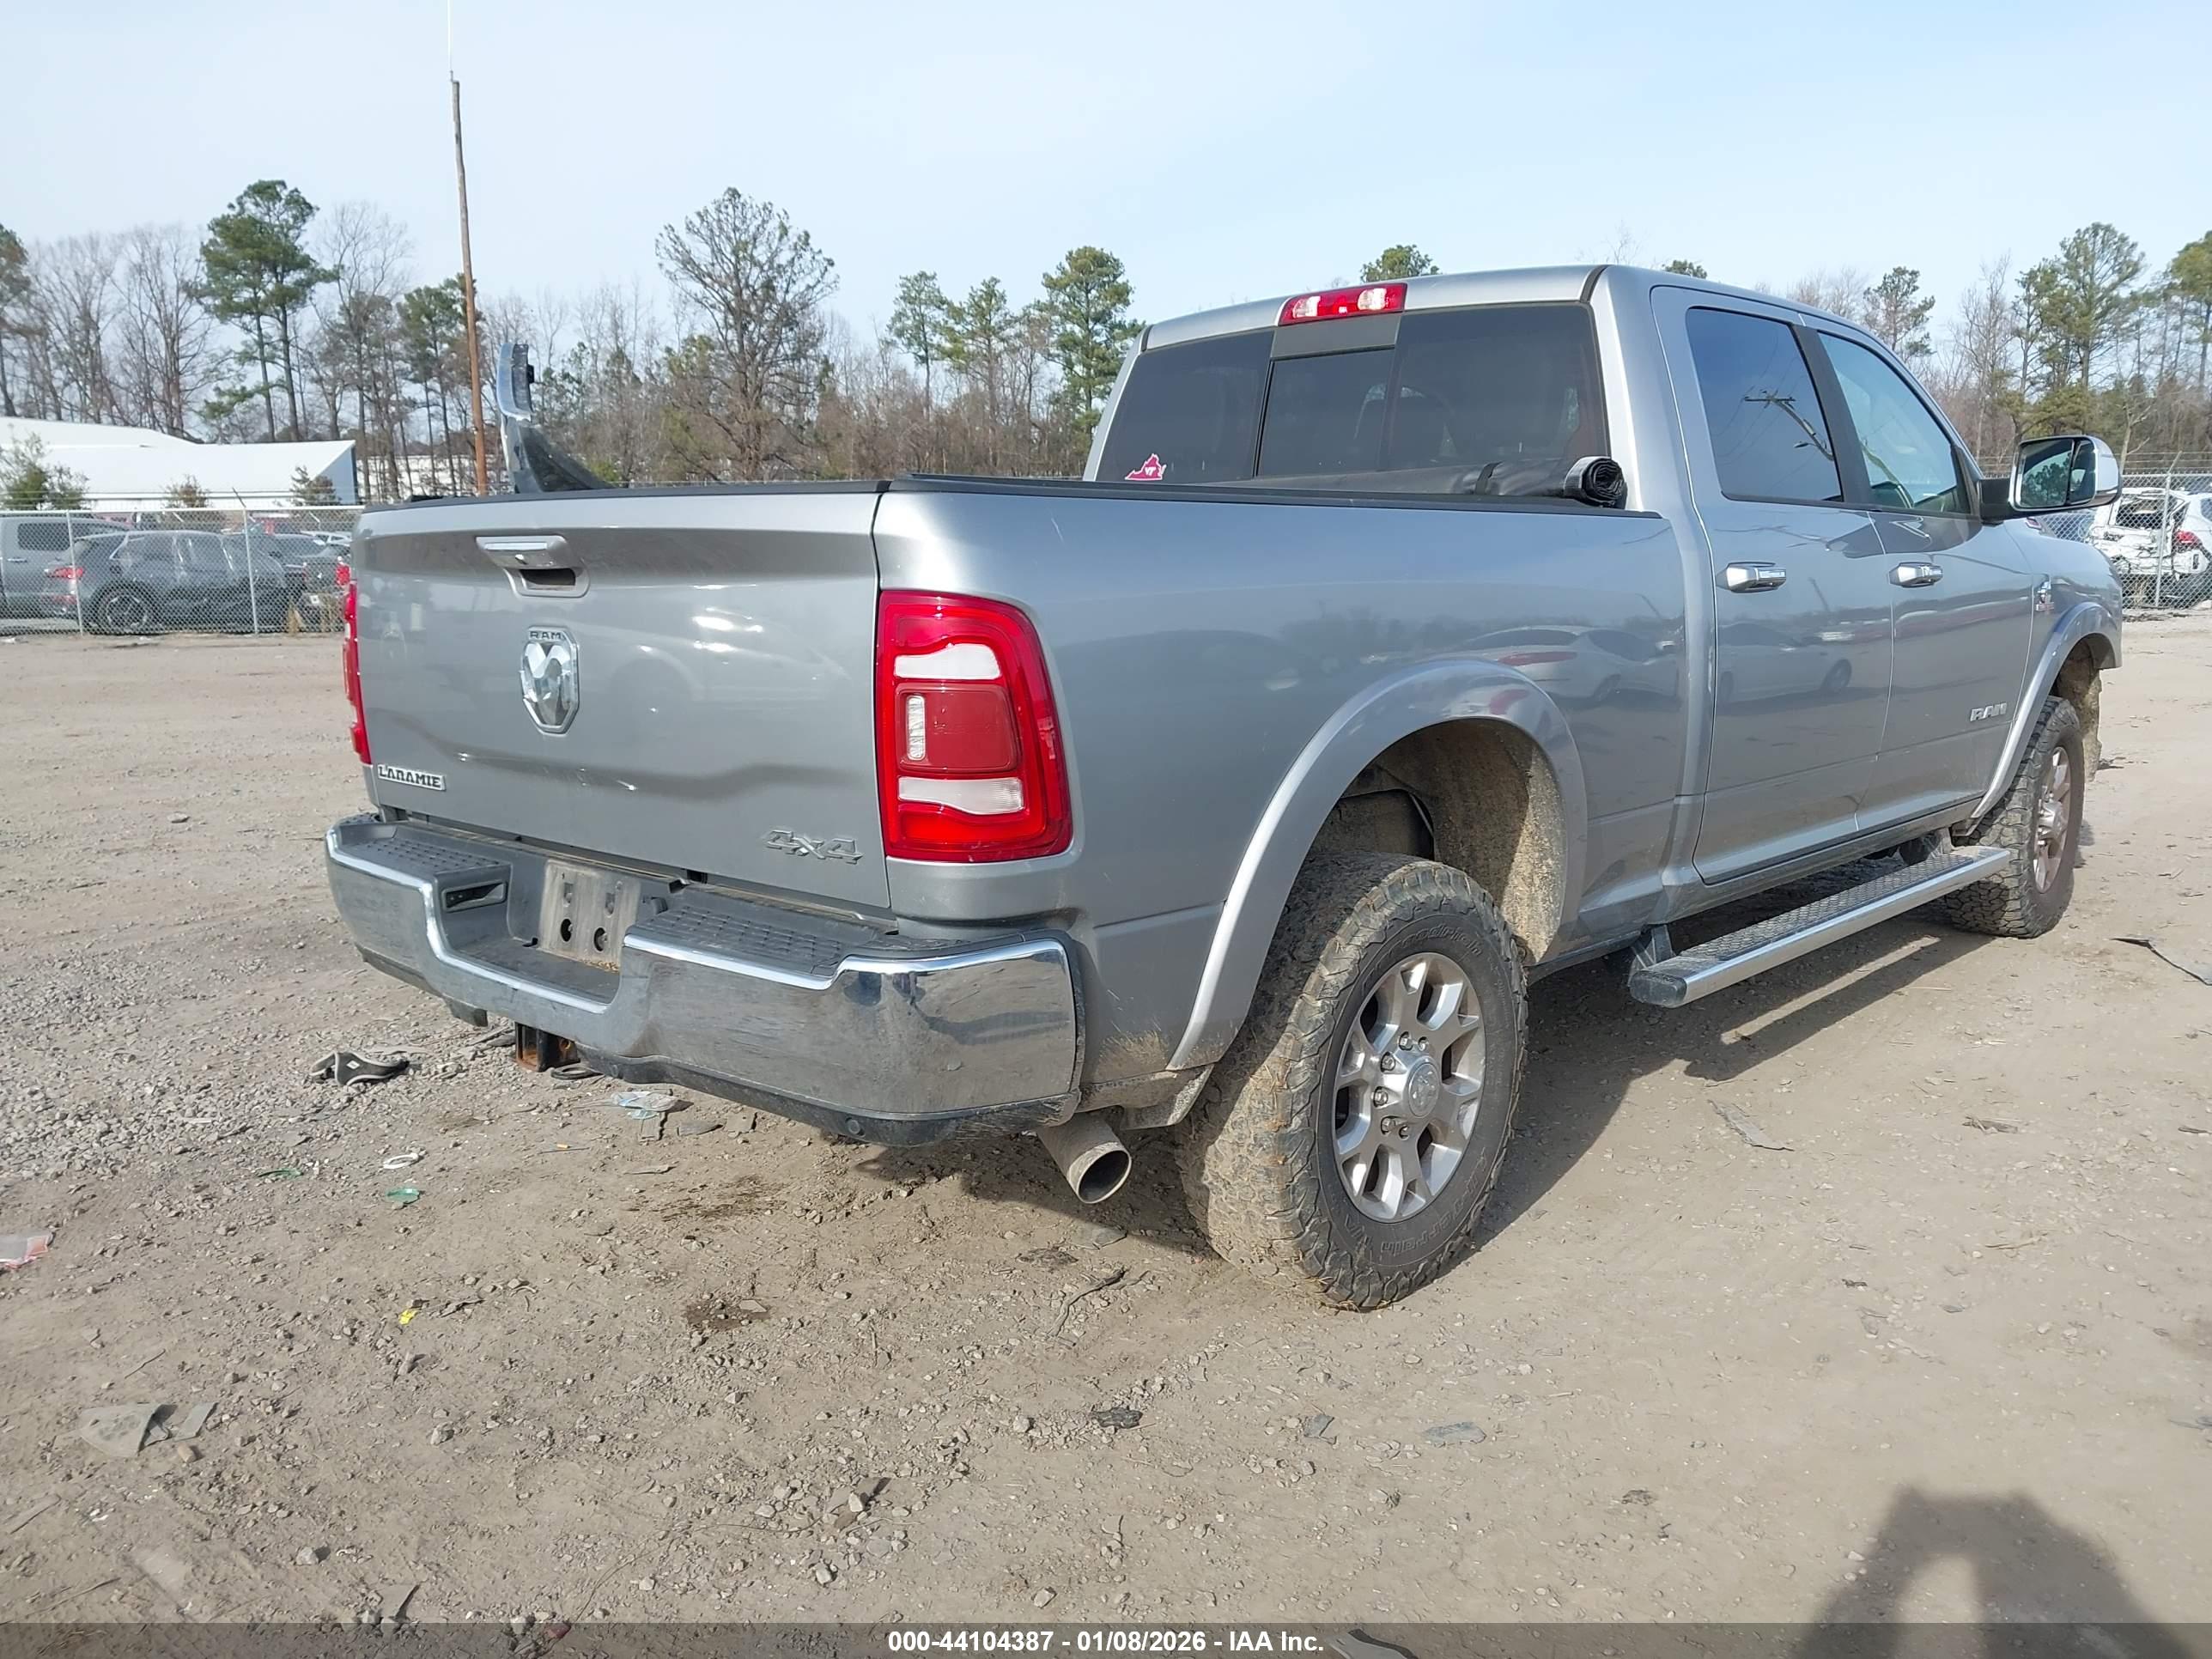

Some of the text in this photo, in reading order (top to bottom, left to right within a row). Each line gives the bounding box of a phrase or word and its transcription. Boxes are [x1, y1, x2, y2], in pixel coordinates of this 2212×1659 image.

[528, 630, 562, 640] RAM
[1970, 702, 2008, 722] RAM
[378, 764, 443, 789] LARAMIE
